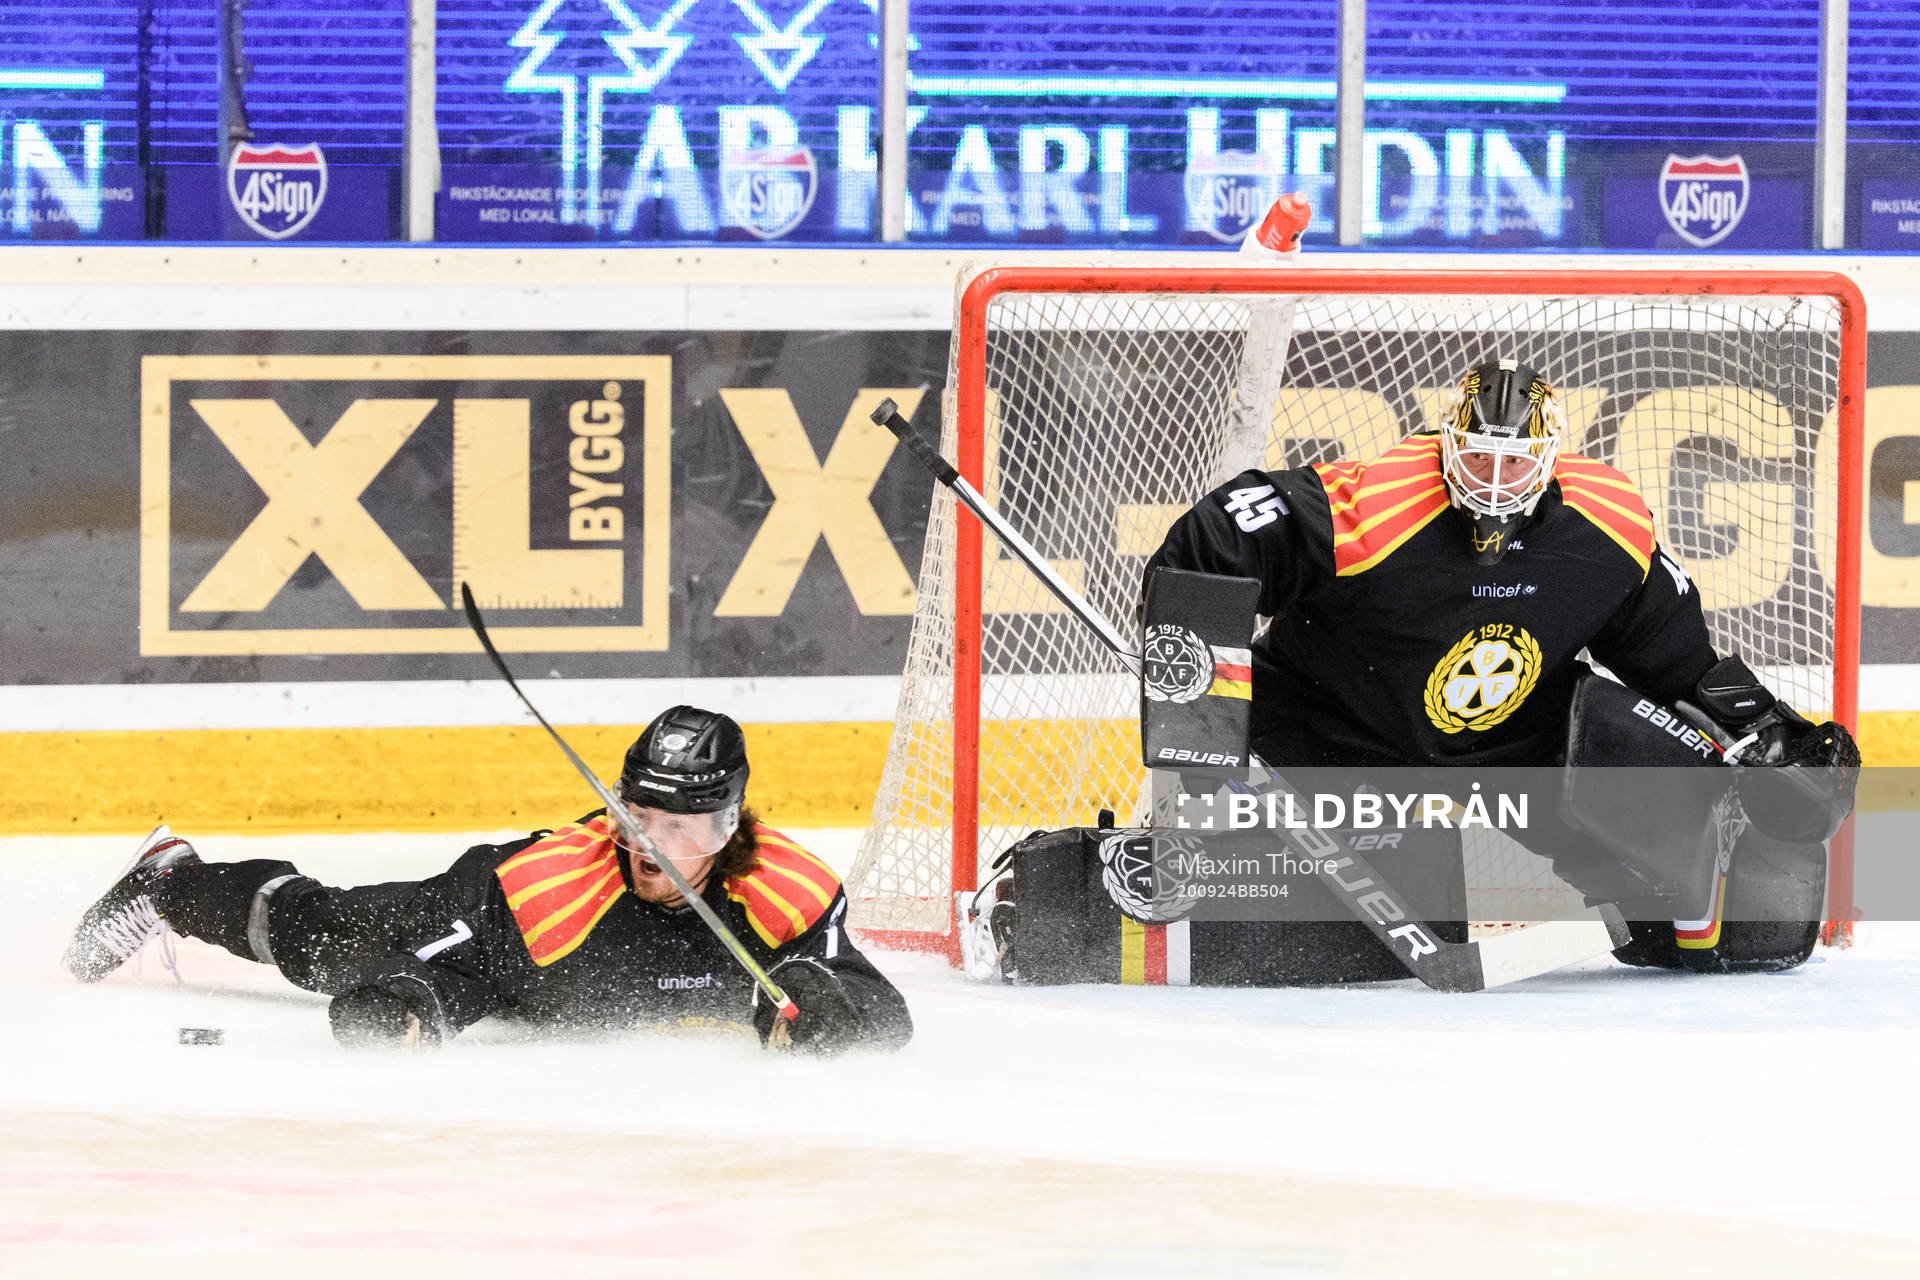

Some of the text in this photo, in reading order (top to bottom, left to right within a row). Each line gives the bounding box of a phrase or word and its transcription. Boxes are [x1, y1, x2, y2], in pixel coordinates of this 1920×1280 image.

[240, 171, 315, 222] 4Sign
[836, 104, 1160, 232] KARL
[1185, 107, 1567, 240] HEDIN
[1670, 181, 1737, 231] 4Sign
[179, 397, 625, 613] XL
[1223, 483, 1291, 533] 45
[1472, 582, 1522, 597] unicef
[1157, 624, 1184, 637] 1912
[1479, 623, 1514, 640] 1912
[1631, 699, 1715, 759] BAUER
[1158, 747, 1241, 768] BAUER
[1256, 787, 1438, 962] BAUER
[657, 972, 713, 990] unicef
